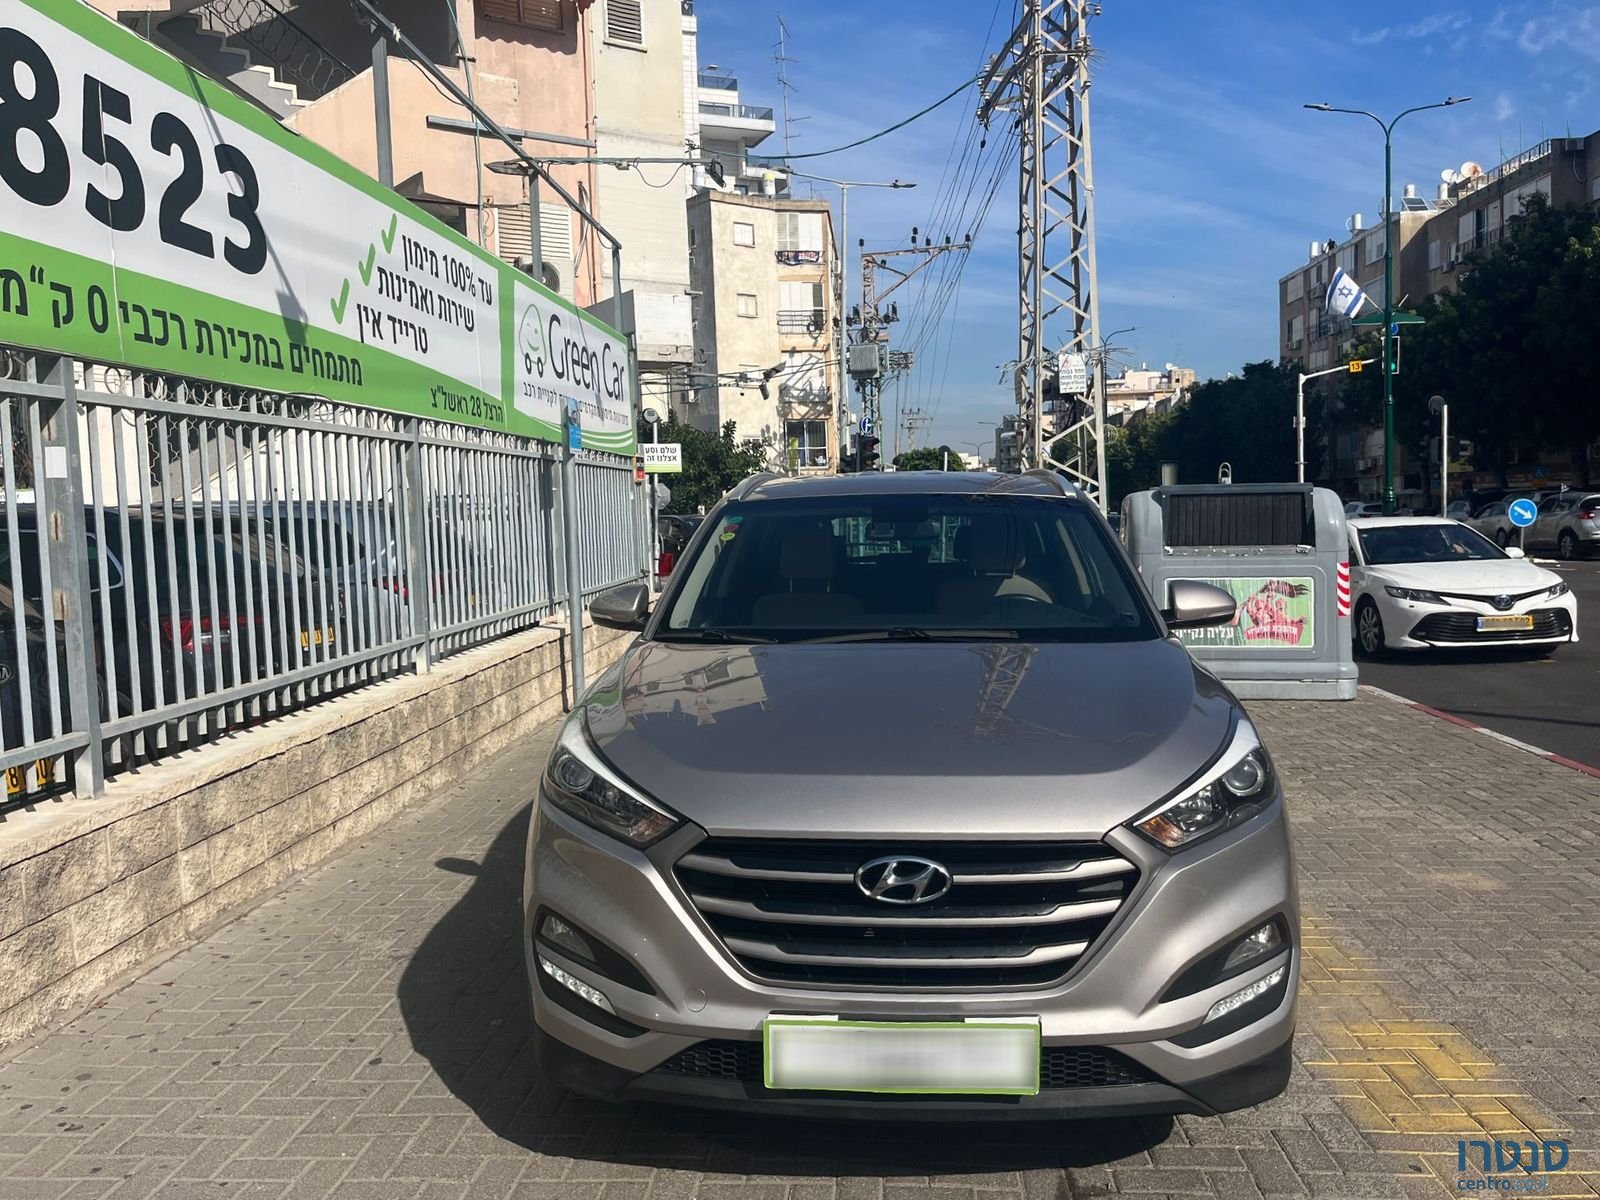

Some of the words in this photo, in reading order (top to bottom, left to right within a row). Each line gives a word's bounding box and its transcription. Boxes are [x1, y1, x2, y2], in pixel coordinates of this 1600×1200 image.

[0, 27, 267, 275] 8523
[402, 234, 439, 279] מימון
[443, 254, 476, 298] 100%
[87, 284, 109, 334] 0
[377, 266, 435, 317] ואמינות
[478, 277, 492, 306] עד
[118, 300, 187, 350] רכבי
[357, 303, 384, 344] אין
[387, 314, 428, 354] טרייד
[438, 294, 475, 333] שירות
[194, 318, 284, 370] במכירת
[289, 342, 363, 386] מתמחים
[548, 313, 601, 394] Green
[602, 342, 624, 402] Car
[1351, 362, 1360, 371] 13
[470, 394, 482, 418] 28
[483, 397, 503, 423] הרצל
[523, 382, 536, 399] רכב
[657, 454, 677, 462] אצלנו
[660, 446, 677, 454] שלם
